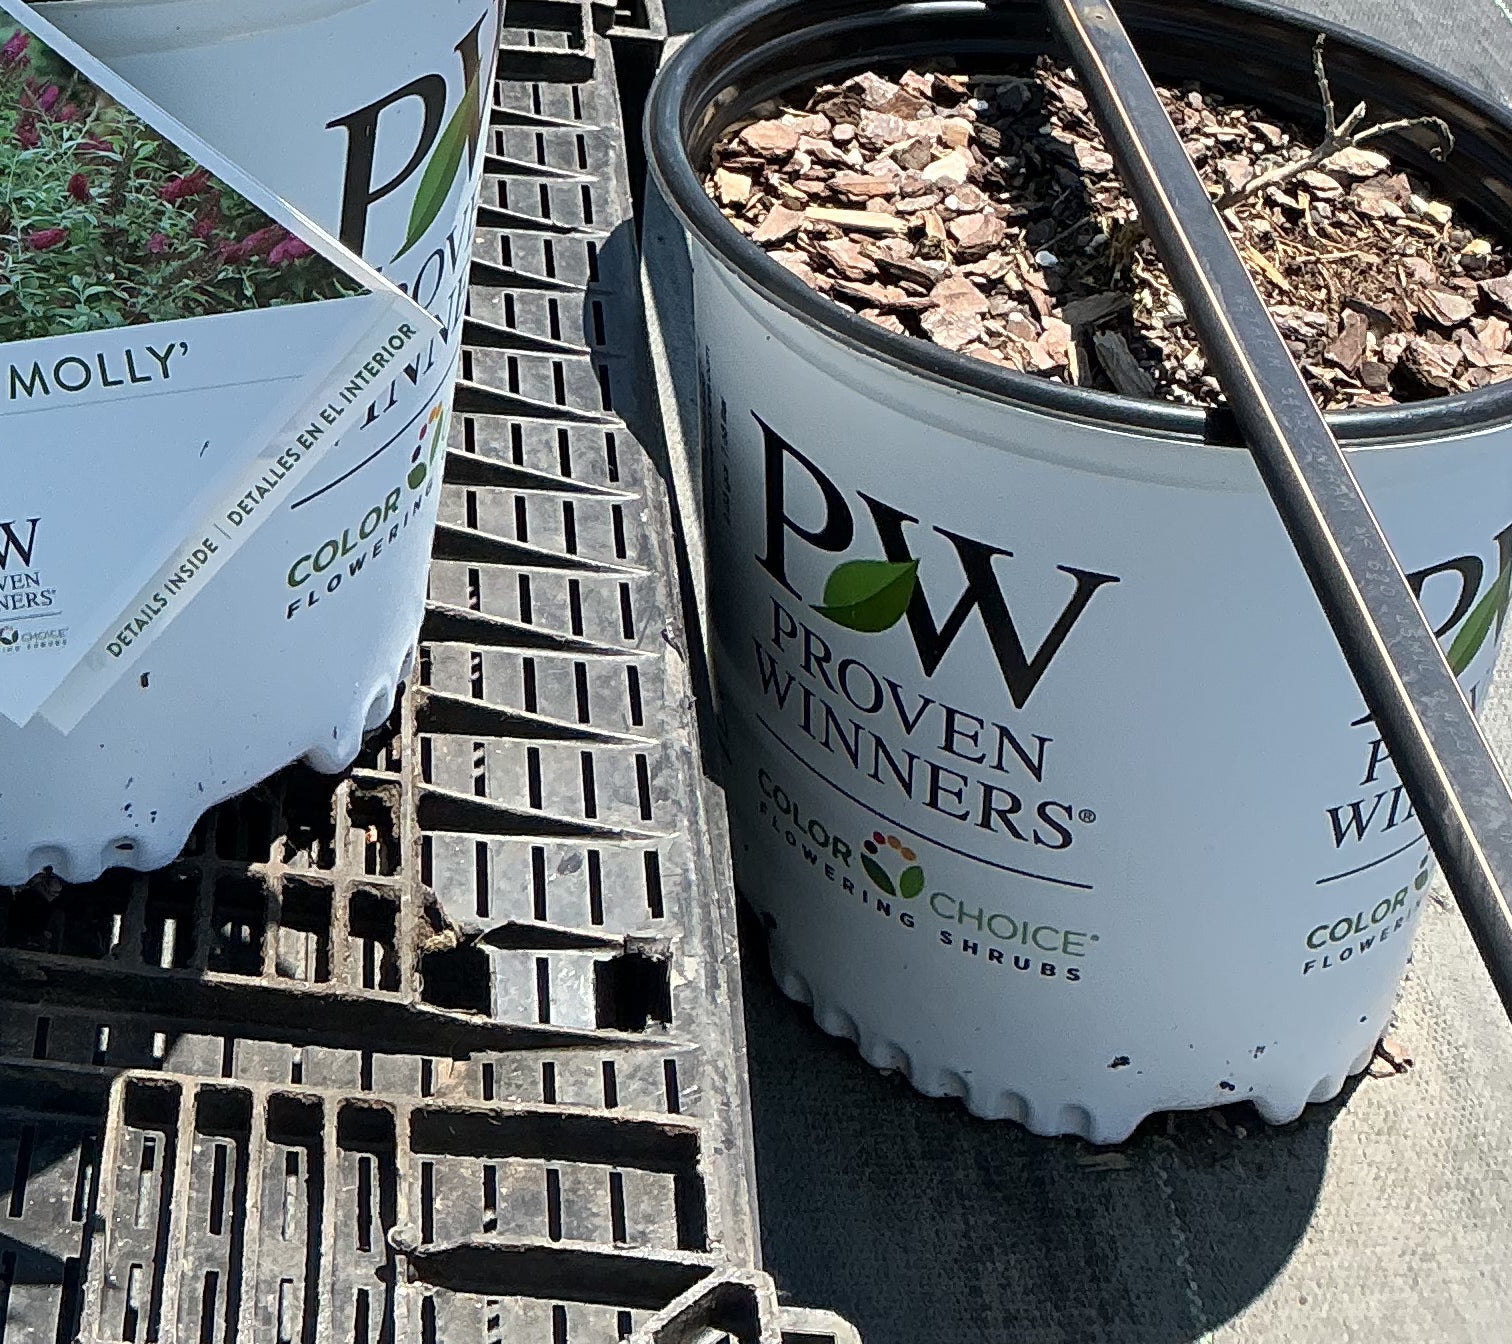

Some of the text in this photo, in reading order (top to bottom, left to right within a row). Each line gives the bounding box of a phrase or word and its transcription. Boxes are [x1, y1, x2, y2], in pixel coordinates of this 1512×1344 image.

[226, 447, 302, 529] DETALLES
[295, 420, 326, 453] EN
[319, 401, 346, 428] EL
[338, 320, 418, 406] INTERIOR
[105, 536, 220, 658] DETAILS INSIDE
[286, 485, 403, 590] COLOR
[749, 408, 1122, 710] PW
[769, 593, 1055, 784] PROVEN
[757, 766, 1088, 958] COLOR CHOICE
[757, 799, 1083, 983] FLOWERING SHRUBS
[1305, 884, 1409, 950] COLOR
